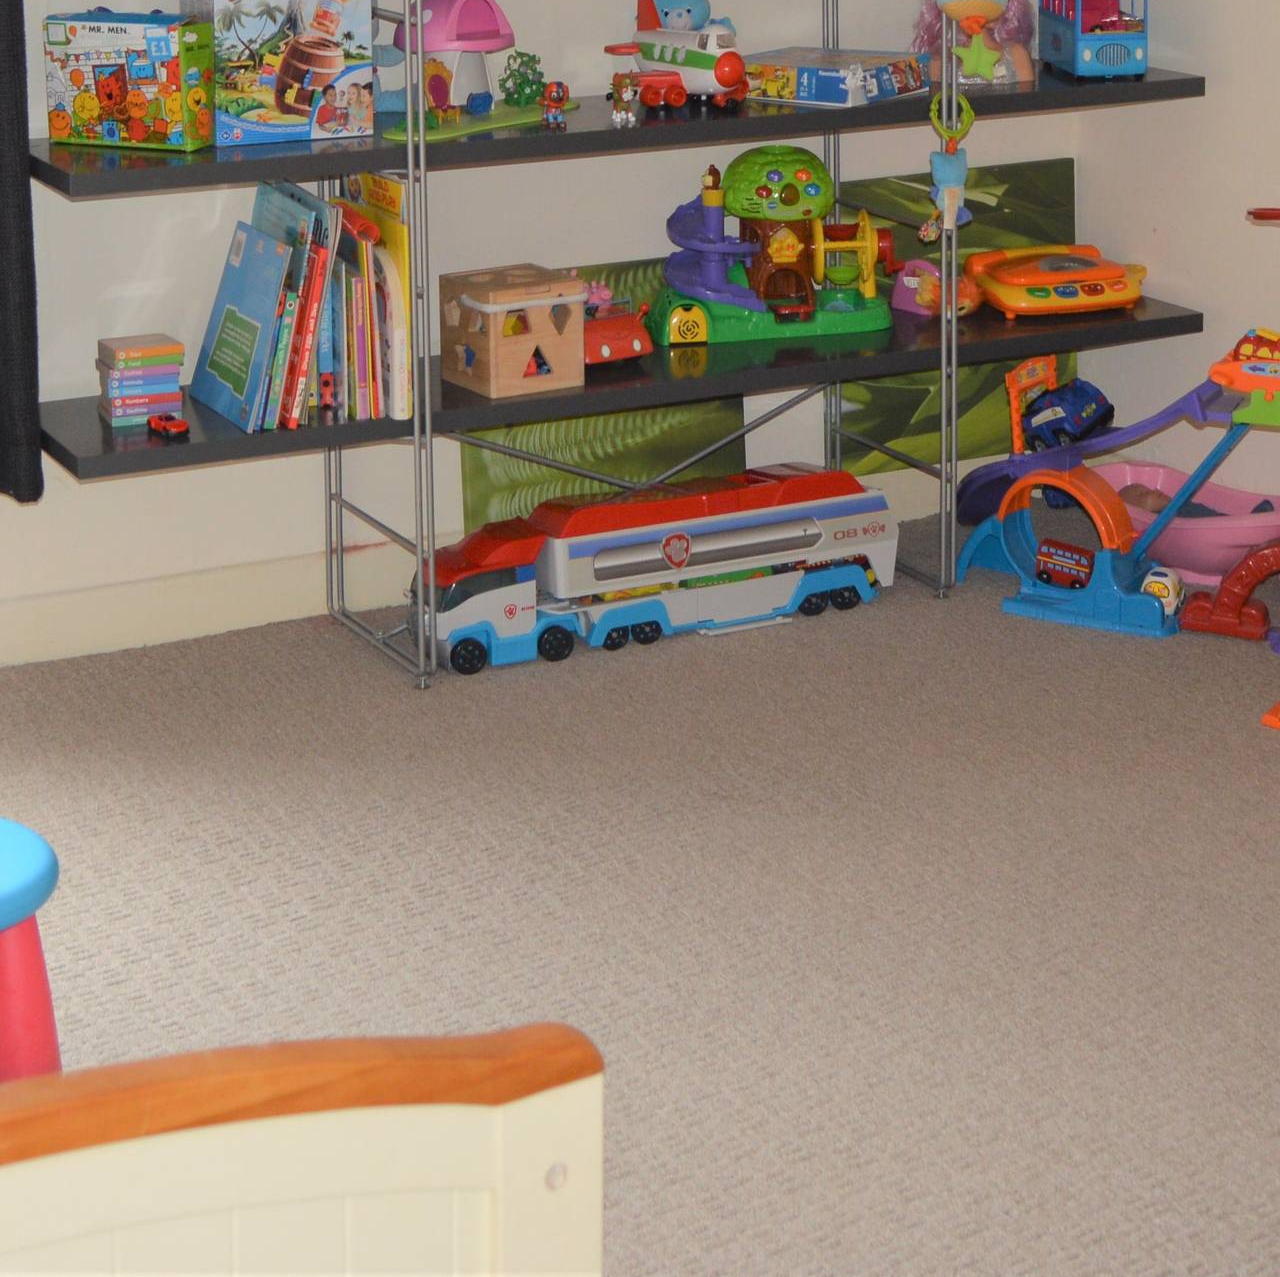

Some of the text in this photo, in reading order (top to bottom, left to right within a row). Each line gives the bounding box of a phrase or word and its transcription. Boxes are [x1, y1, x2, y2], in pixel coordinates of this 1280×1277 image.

[88, 25, 128, 35] MR. MEN
[833, 528, 858, 540] 08
